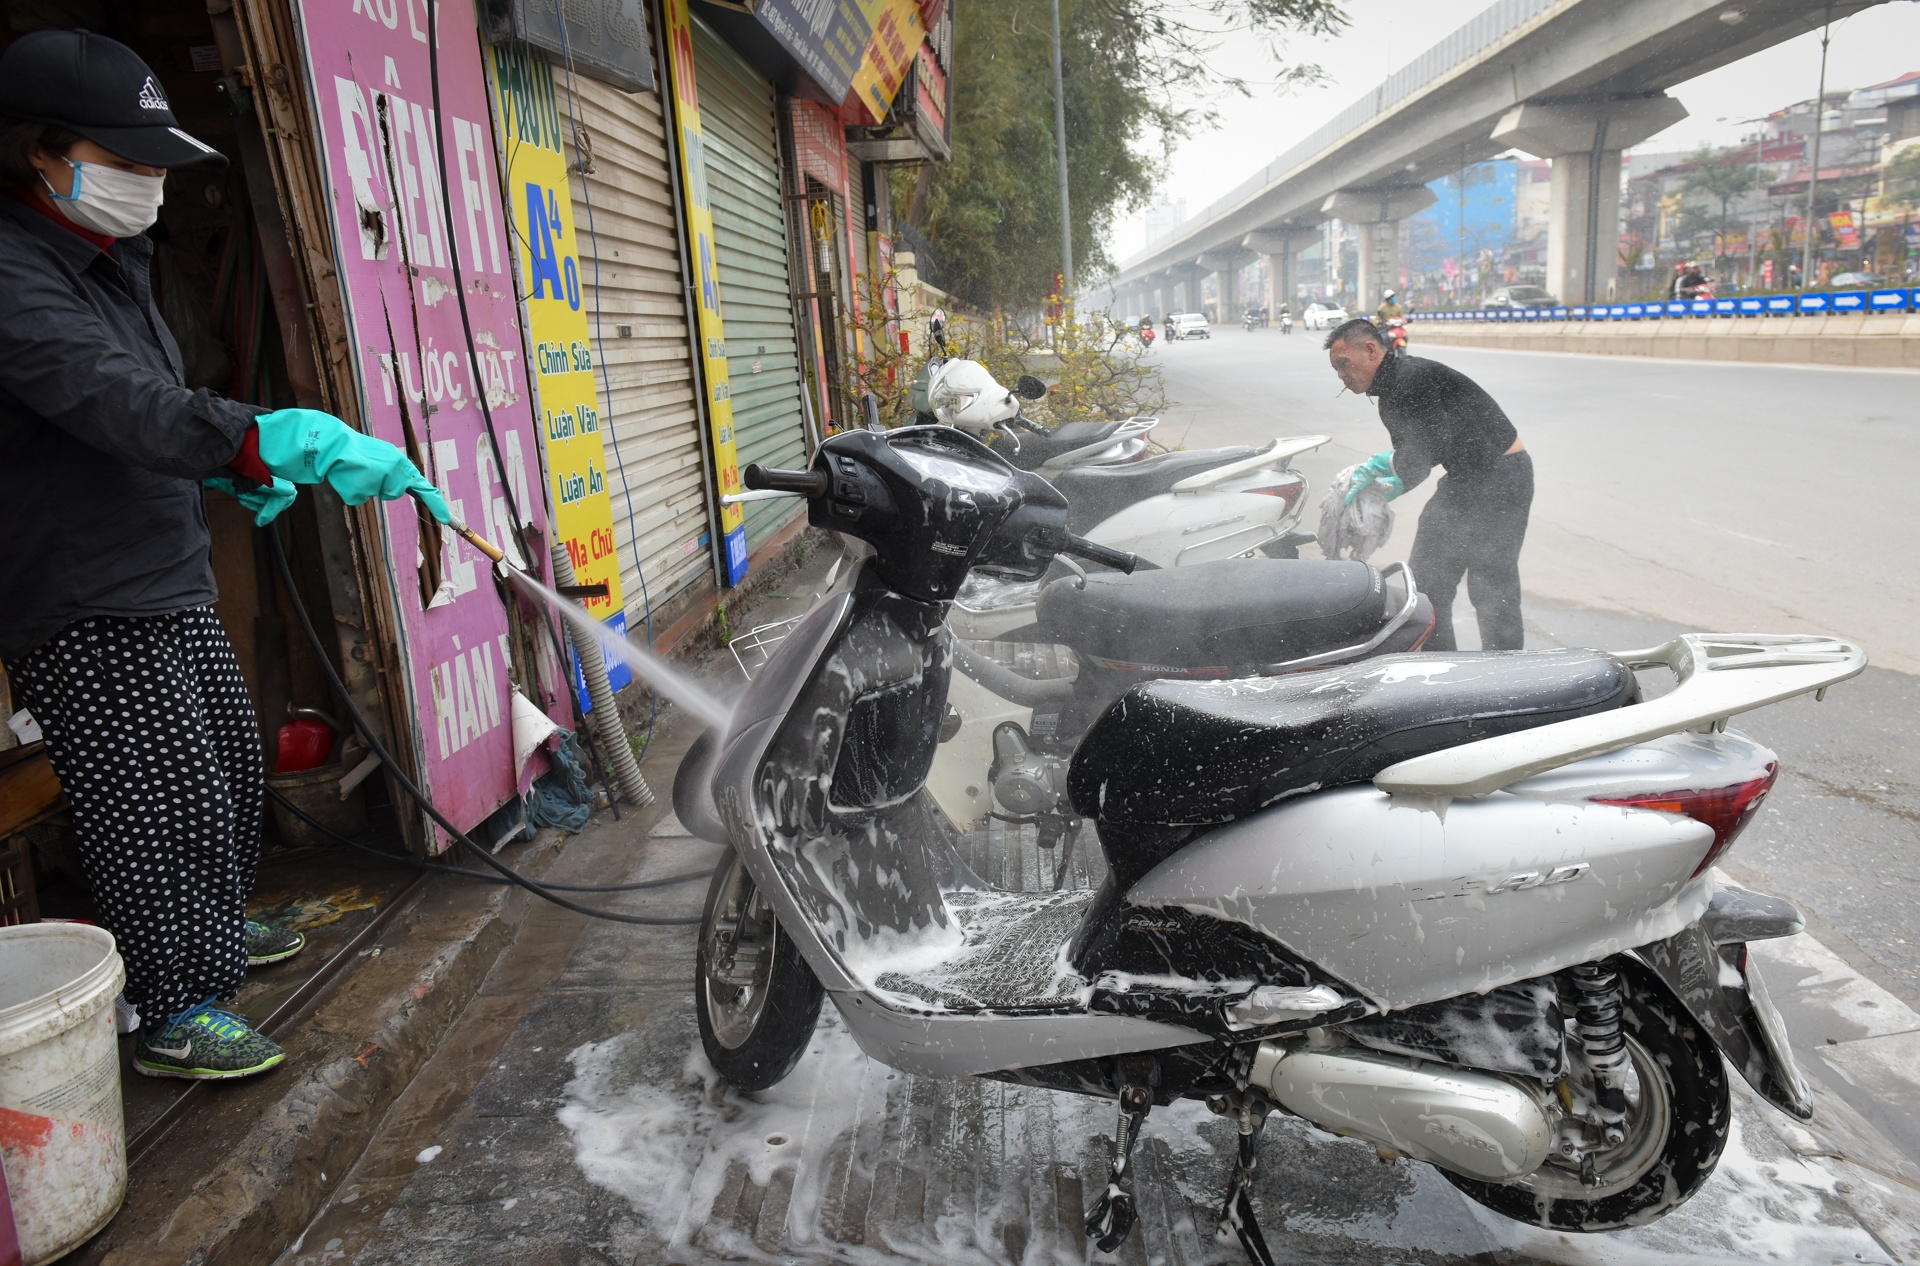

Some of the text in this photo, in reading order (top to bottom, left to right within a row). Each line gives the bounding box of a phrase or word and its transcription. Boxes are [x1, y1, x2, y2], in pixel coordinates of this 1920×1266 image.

[139, 98, 169, 110] adidas
[452, 116, 502, 275] FI
[538, 341, 592, 374] Chỉnh Sửa
[547, 404, 599, 445] Luận Văn
[558, 458, 604, 507] Luận Án
[566, 526, 614, 573] Mạ Chữ
[1141, 665, 1189, 674] HONDA
[430, 635, 501, 762] HÀN
